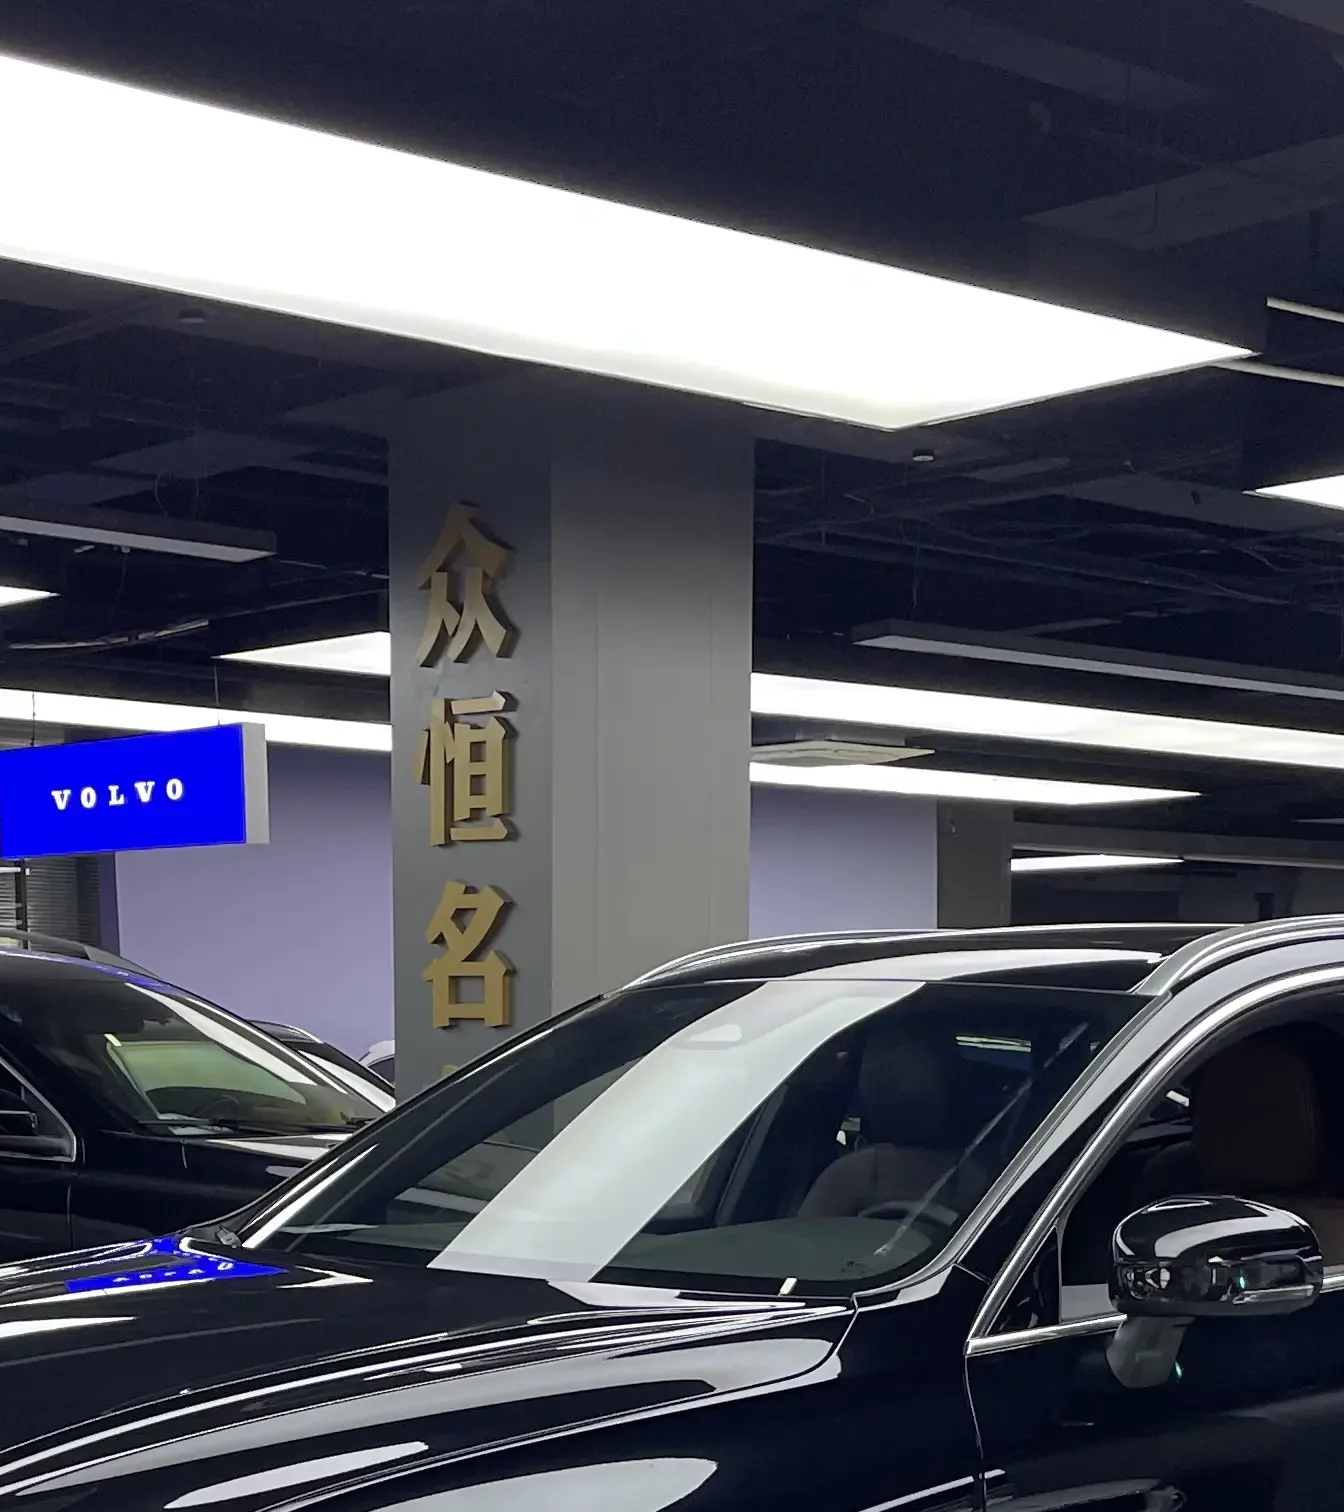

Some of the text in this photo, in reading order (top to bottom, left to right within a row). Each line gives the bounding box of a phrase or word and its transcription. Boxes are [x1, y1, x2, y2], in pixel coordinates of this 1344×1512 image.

[51, 778, 184, 811] VOLVO
[413, 500, 518, 1076] 众恒名
